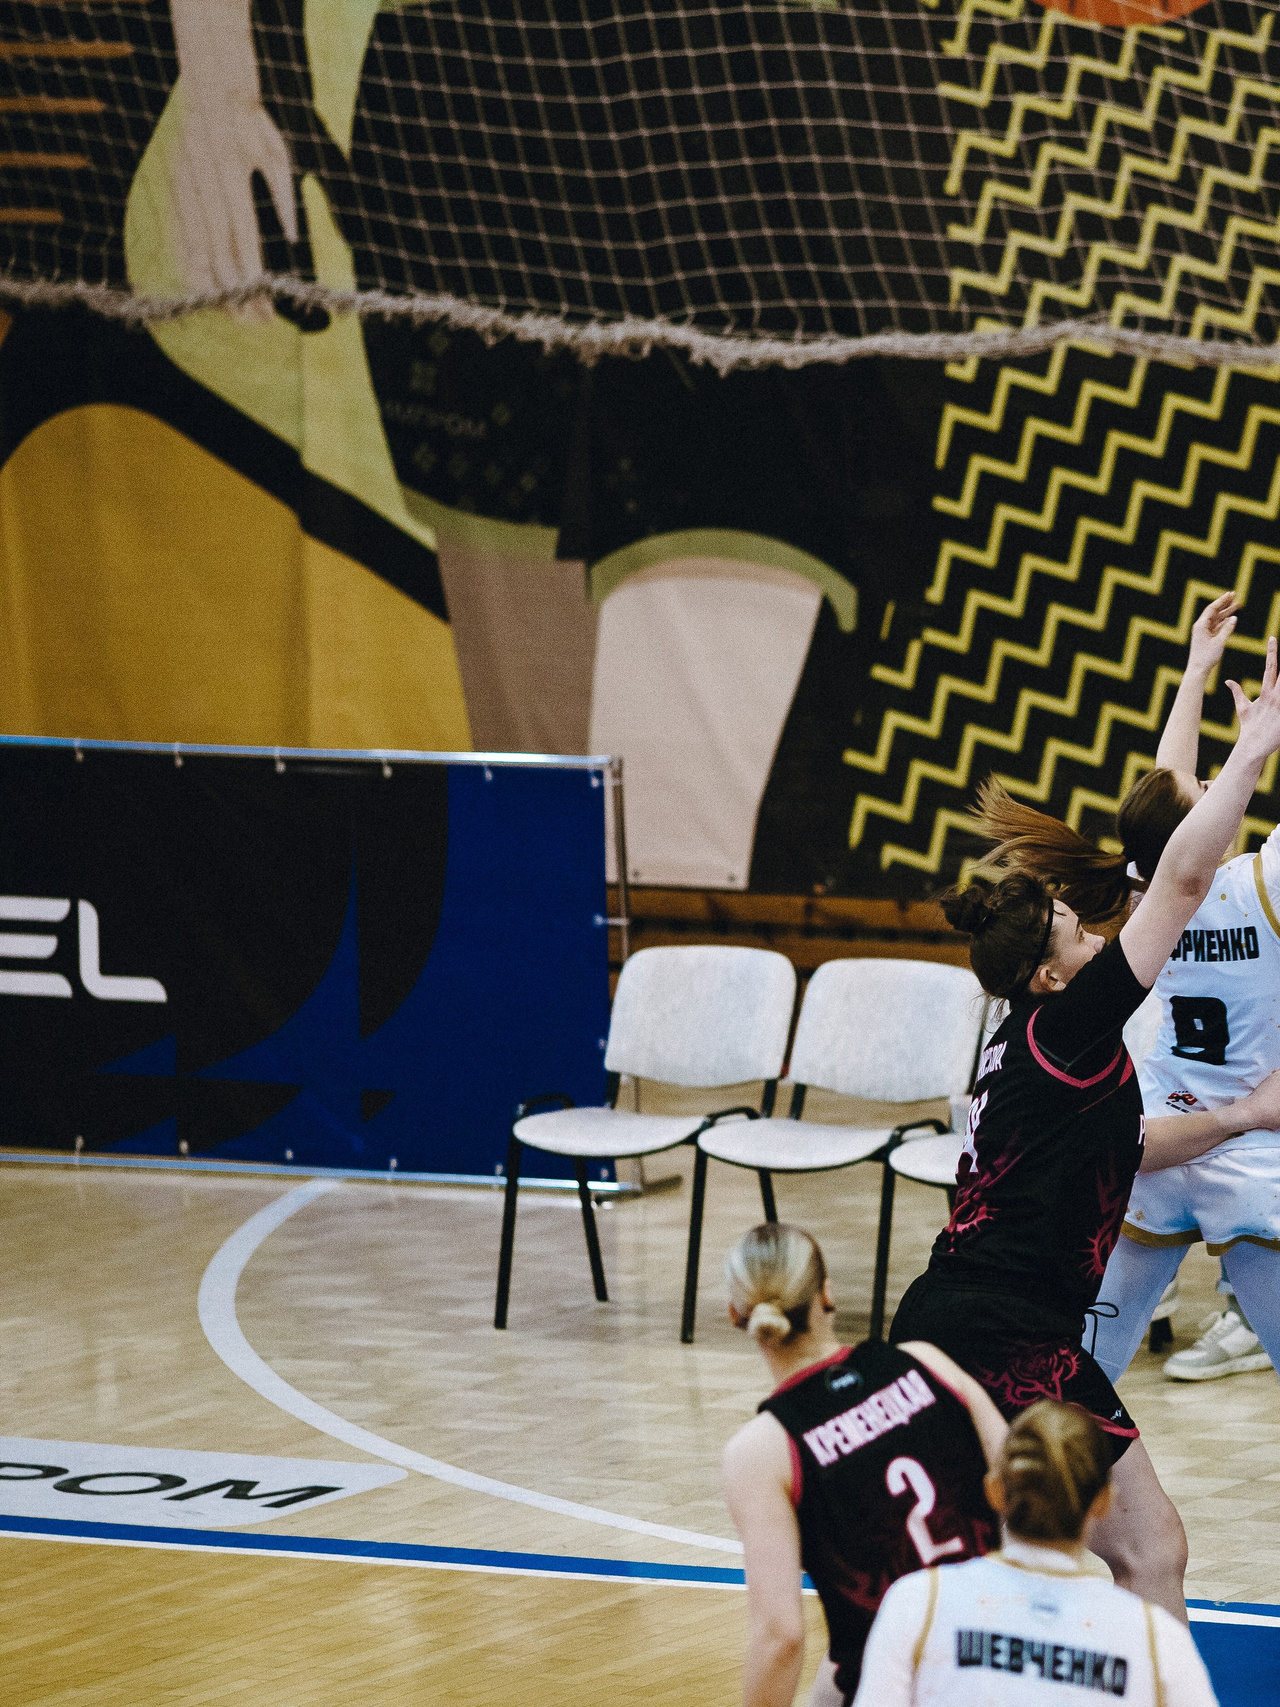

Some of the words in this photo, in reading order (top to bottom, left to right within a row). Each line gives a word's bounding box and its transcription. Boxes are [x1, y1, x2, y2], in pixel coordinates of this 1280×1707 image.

[1169, 995, 1229, 1065] 9
[885, 1455, 965, 1566] 2
[957, 1630, 1128, 1697] ШЕВЧЕНКО
